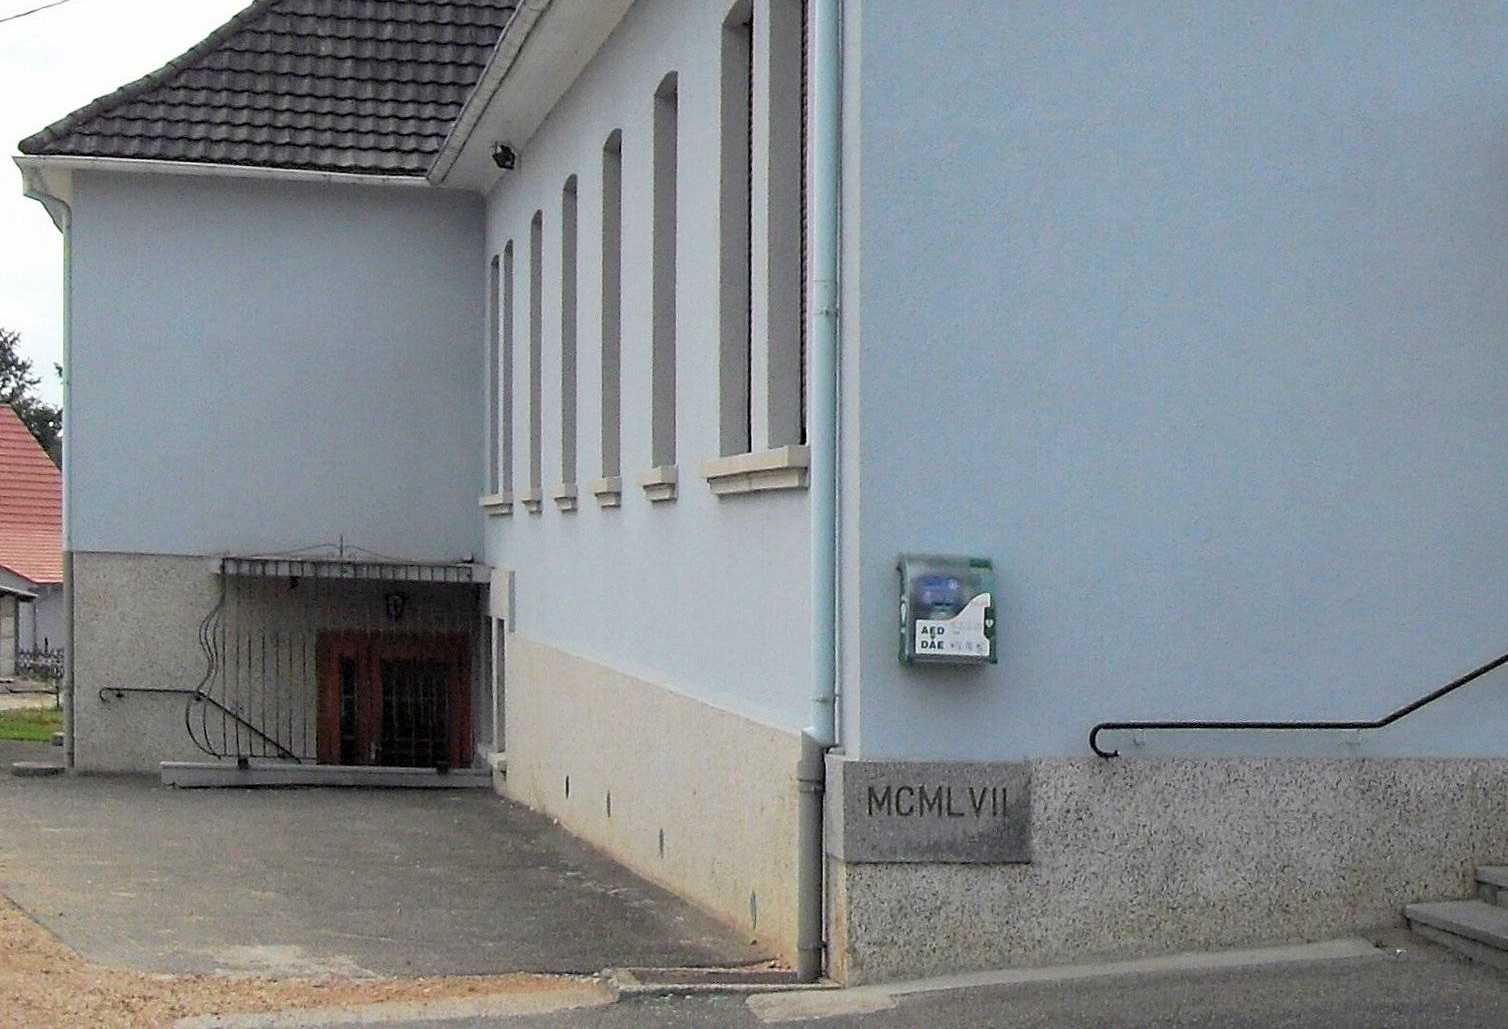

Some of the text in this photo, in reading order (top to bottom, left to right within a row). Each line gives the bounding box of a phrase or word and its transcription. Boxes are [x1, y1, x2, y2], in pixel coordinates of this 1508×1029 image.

[921, 626, 945, 635] AED
[921, 640, 944, 650] DAE
[867, 784, 1007, 819] MCMLVII
